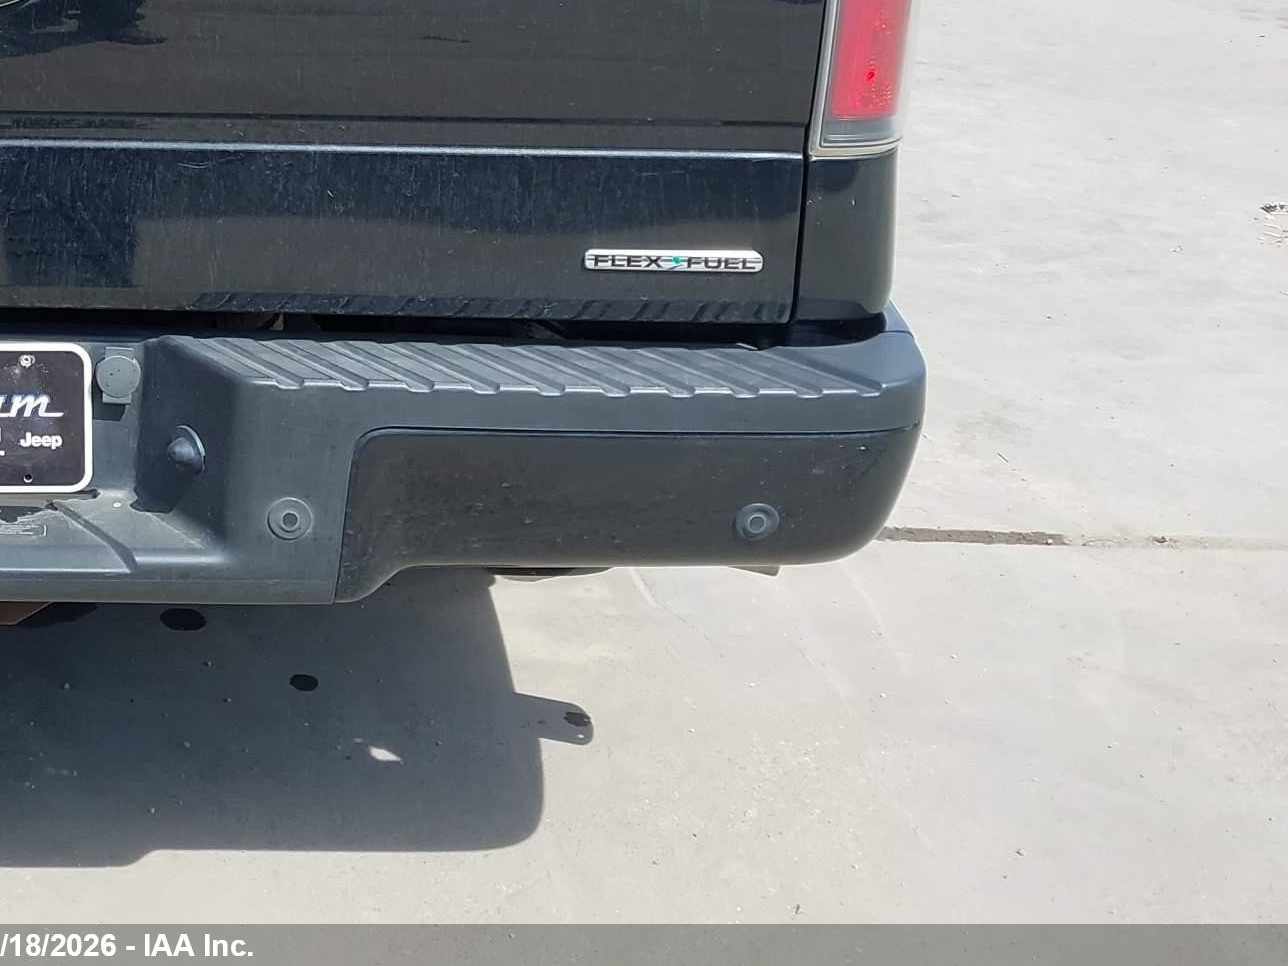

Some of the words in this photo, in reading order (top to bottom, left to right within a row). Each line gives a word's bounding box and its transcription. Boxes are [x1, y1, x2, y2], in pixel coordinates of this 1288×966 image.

[593, 254, 664, 269] FLEX
[687, 256, 756, 270] FUEL
[19, 432, 63, 450] Jeep
